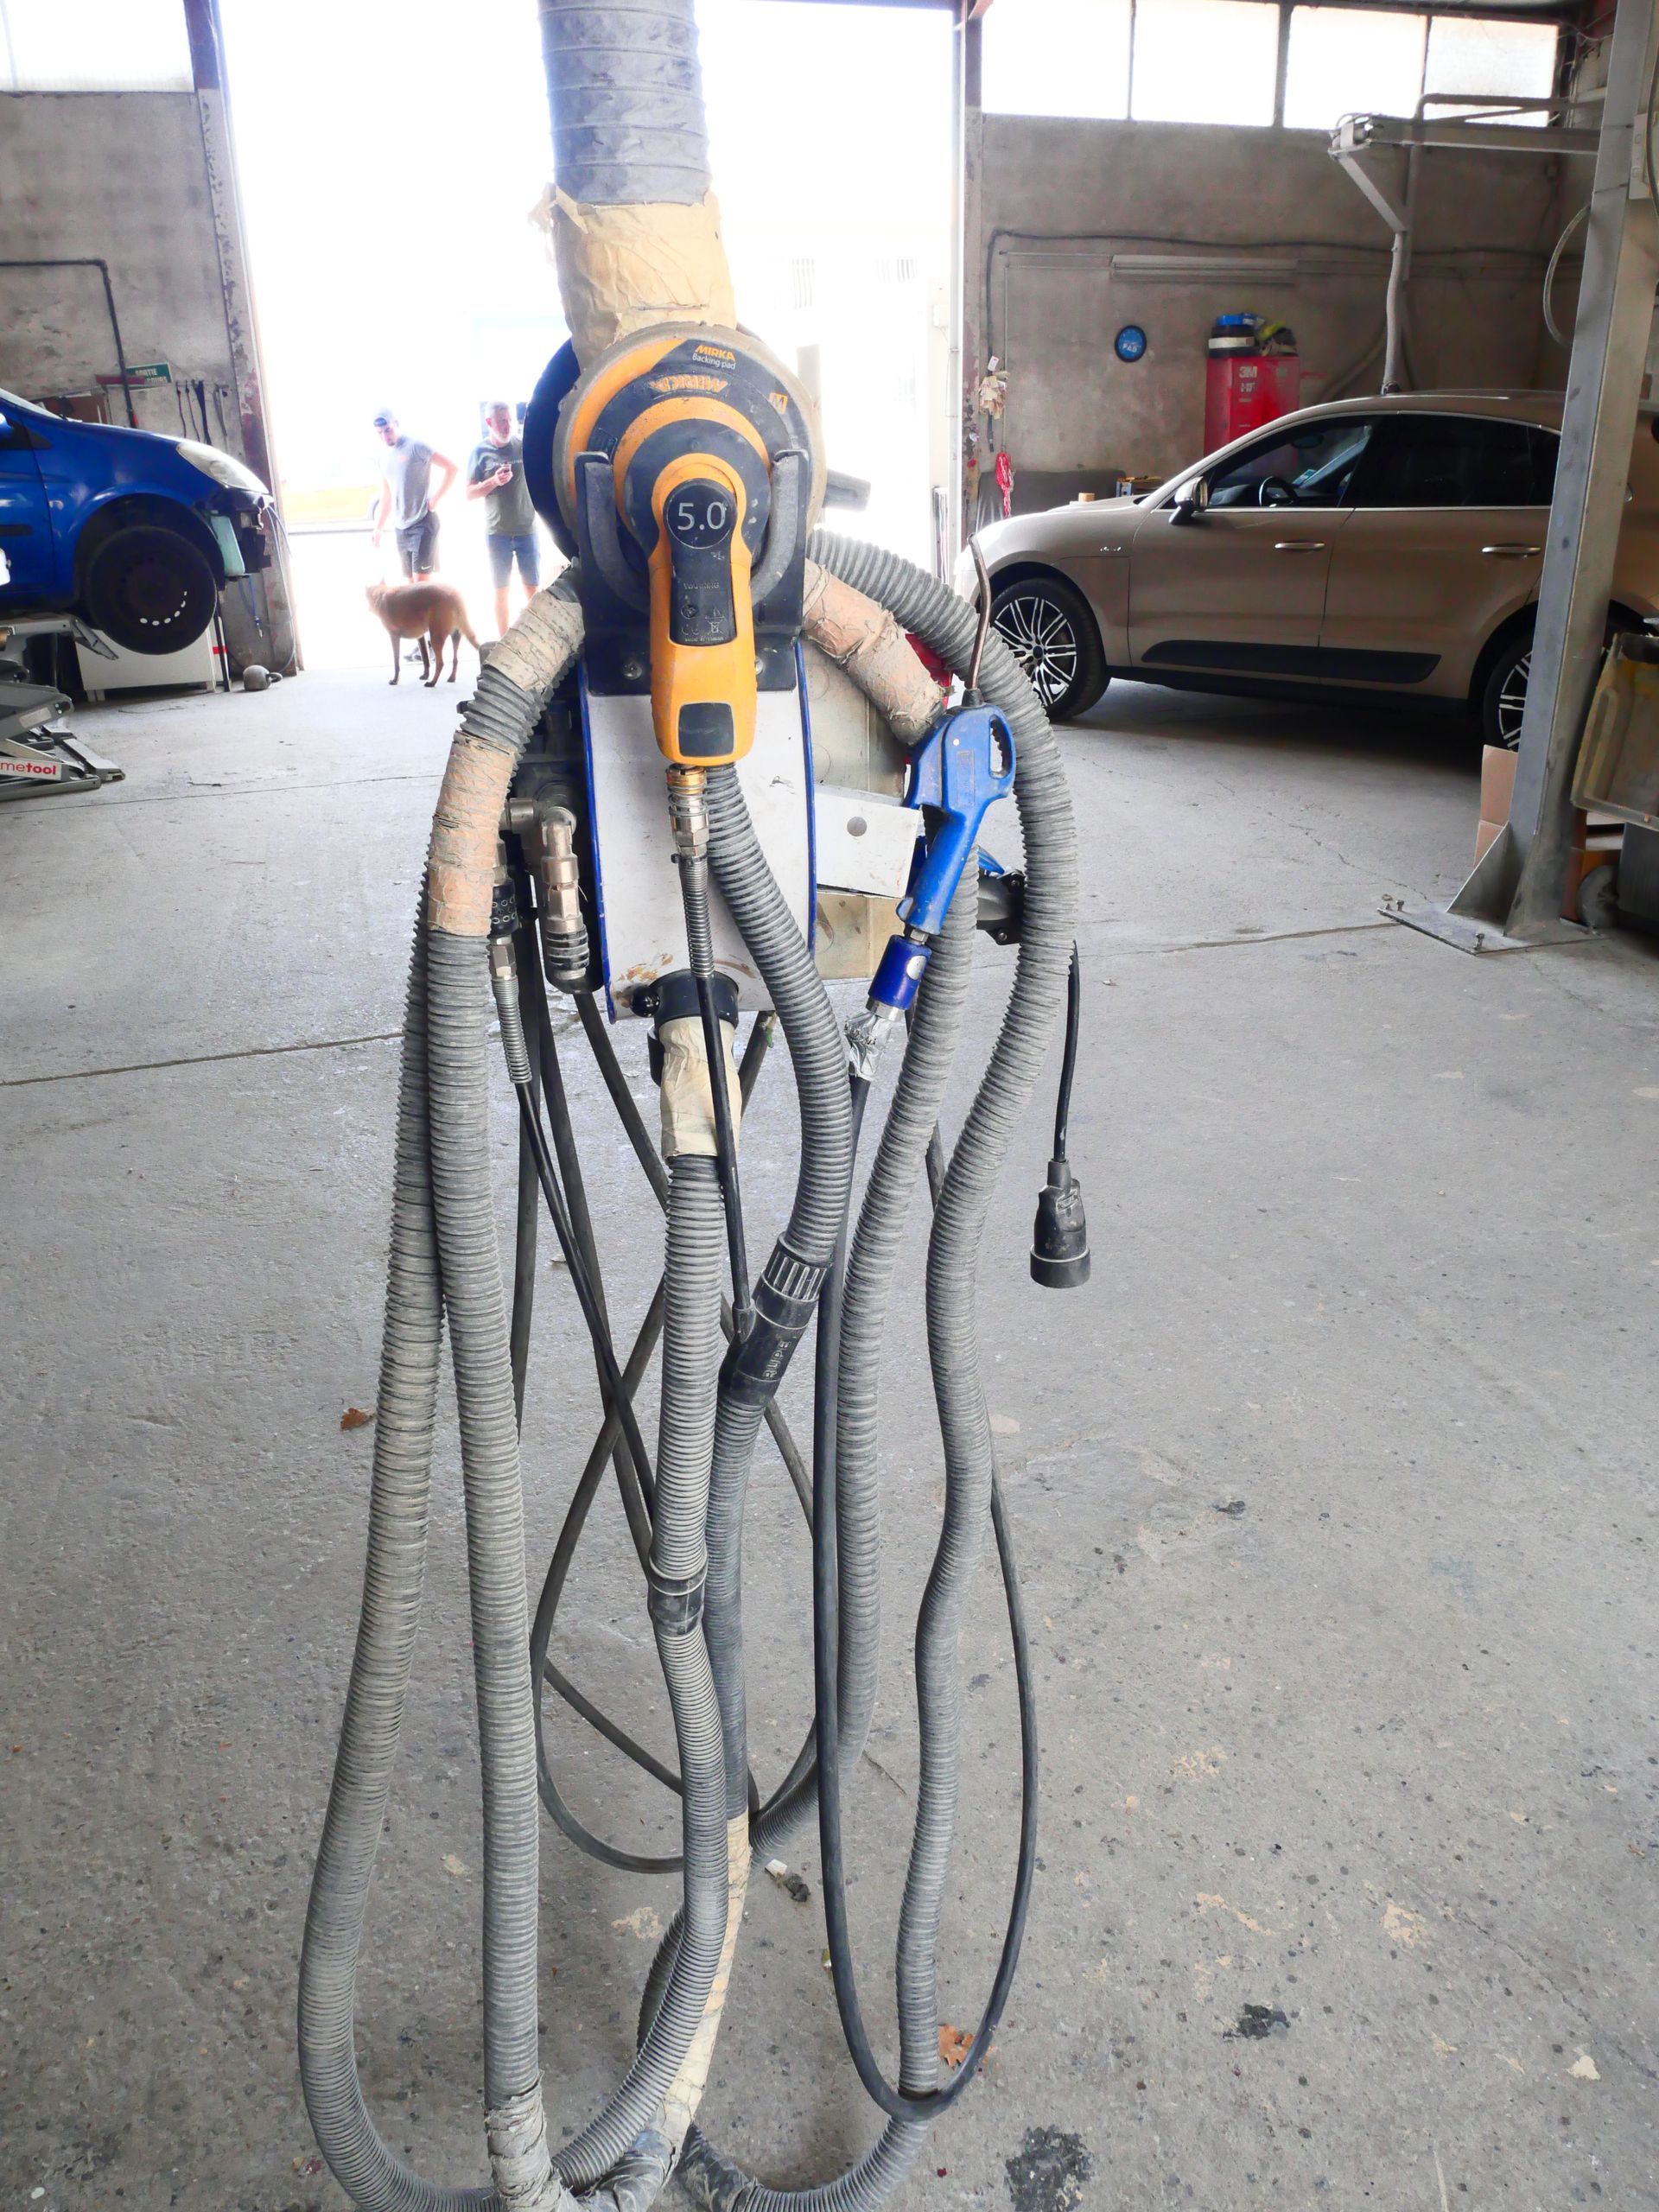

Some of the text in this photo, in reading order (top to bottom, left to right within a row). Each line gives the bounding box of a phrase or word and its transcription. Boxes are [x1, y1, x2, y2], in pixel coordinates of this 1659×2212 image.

[692, 353, 736, 370] Backing pad
[695, 345, 736, 361] MIRKA
[1238, 365, 1258, 378] 3M
[649, 373, 728, 393] MIRKA
[677, 501, 727, 531] 5.0
[762, 1335, 792, 1380] RUPE
